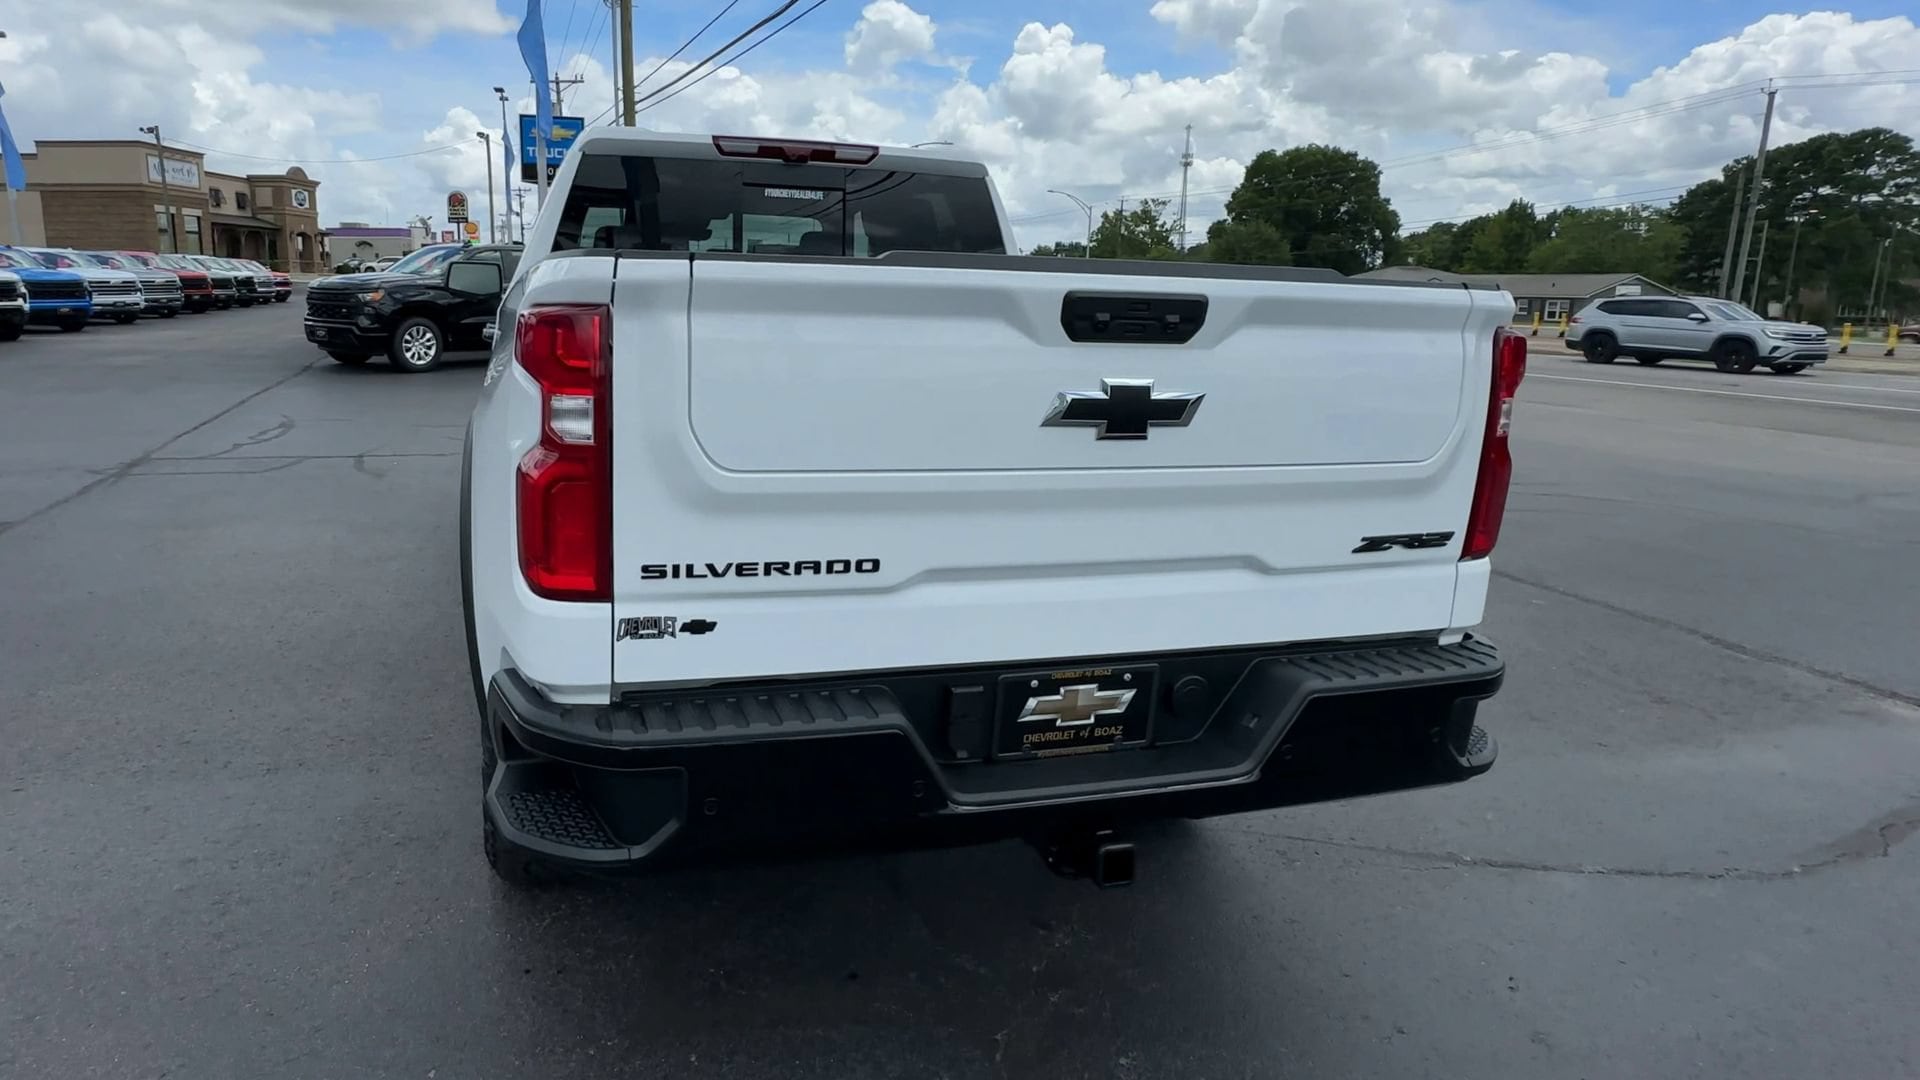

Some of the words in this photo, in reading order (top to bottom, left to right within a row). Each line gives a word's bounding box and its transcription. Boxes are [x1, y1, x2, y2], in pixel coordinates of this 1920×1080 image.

[1351, 531, 1456, 554] ZR2
[640, 558, 881, 580] SILVERADO
[616, 616, 677, 642] CHEVROLET
[1023, 729, 1076, 744] CHEVROLET
[1094, 725, 1124, 737] BOAZ
